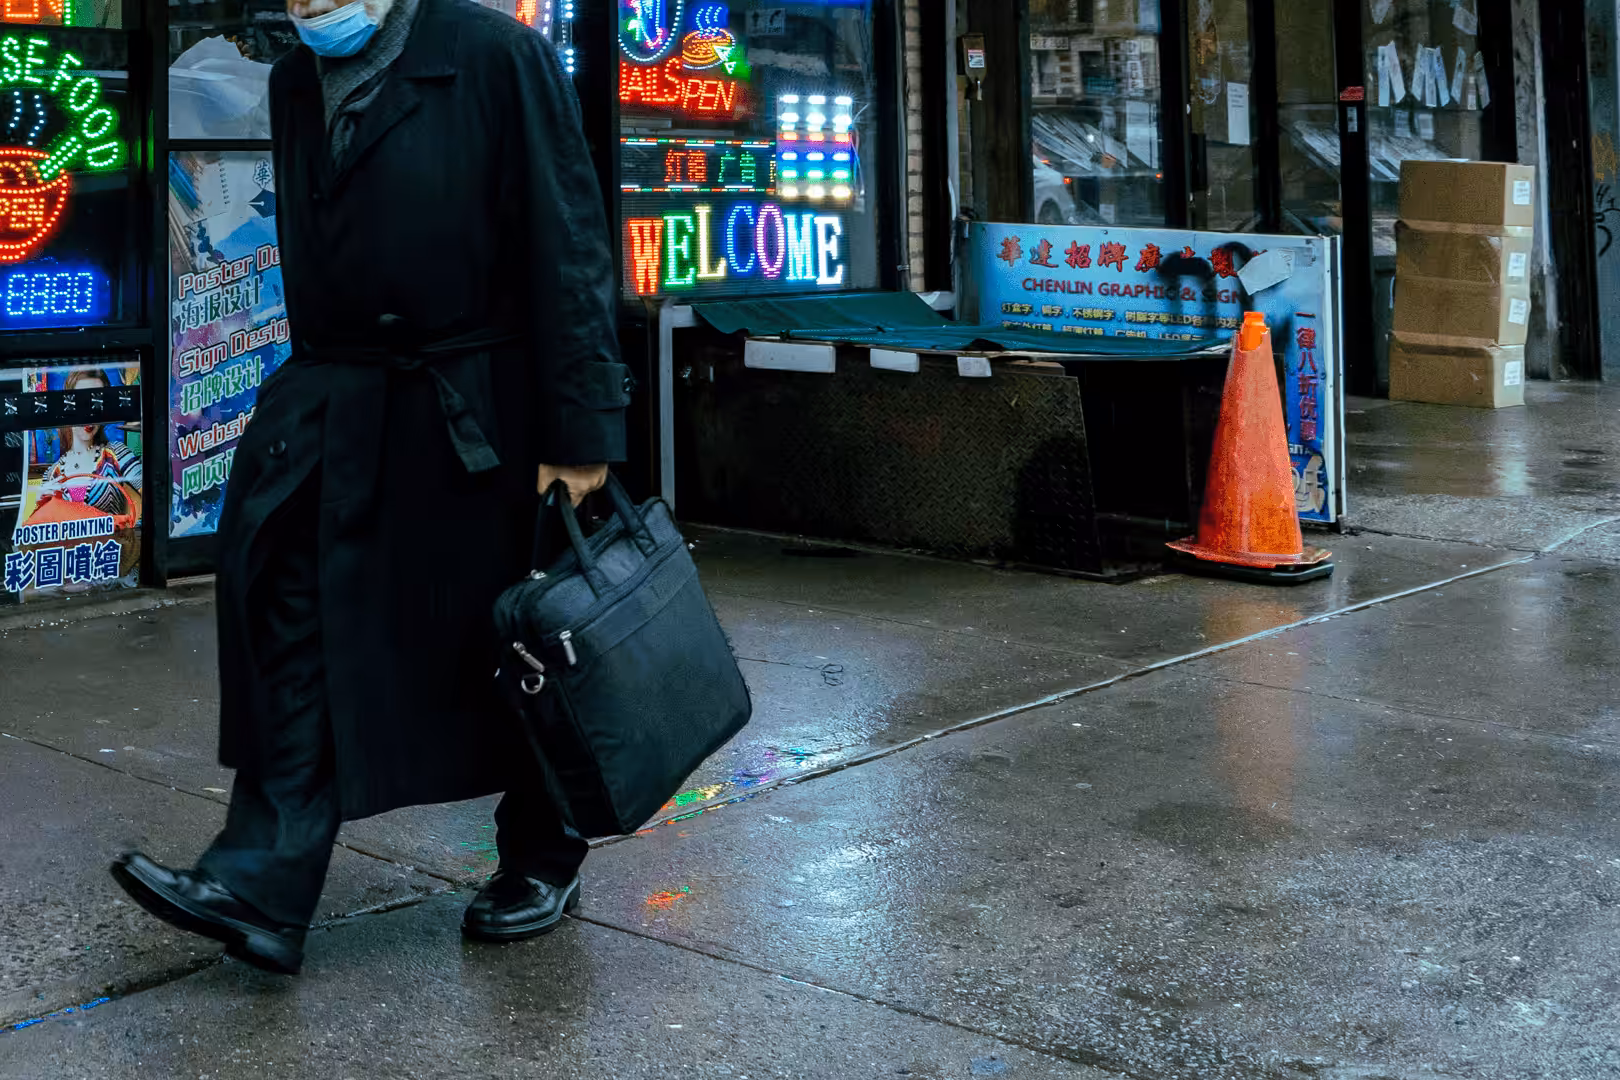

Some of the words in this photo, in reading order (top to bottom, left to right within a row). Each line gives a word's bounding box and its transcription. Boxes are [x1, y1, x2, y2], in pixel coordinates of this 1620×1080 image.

[50, 52, 119, 169] FOOD
[628, 204, 843, 295] WELCOME
[178, 255, 253, 300] Poster
[1022, 277, 1093, 295] CHENLIN
[1181, 286, 1197, 302] &
[179, 342, 227, 377] Sign
[14, 522, 59, 546] POSTER
[61, 516, 114, 540] PRINTING
